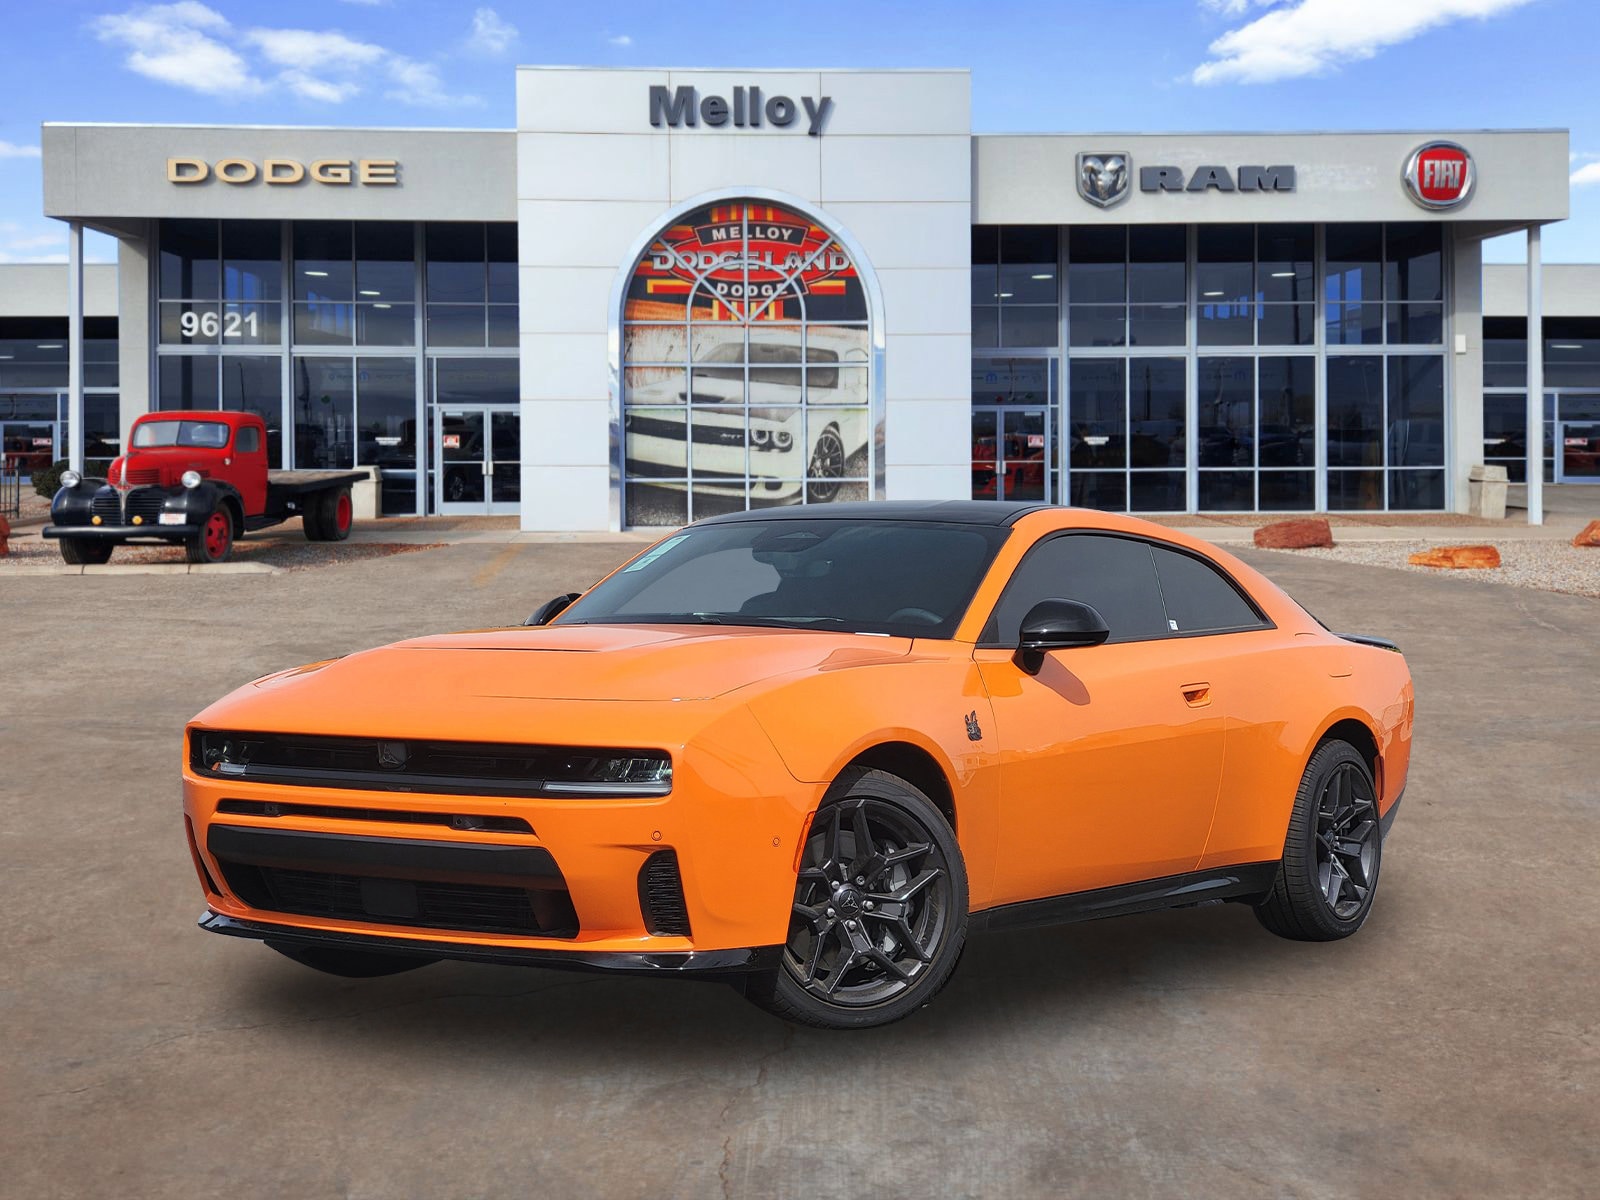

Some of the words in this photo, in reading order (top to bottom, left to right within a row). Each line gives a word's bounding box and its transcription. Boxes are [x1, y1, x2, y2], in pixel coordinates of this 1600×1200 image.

[649, 85, 832, 136] Melloy
[167, 158, 398, 184] DODGE
[1140, 165, 1295, 191] RAM
[1423, 159, 1463, 188] FIAT
[181, 311, 257, 337] 9621
